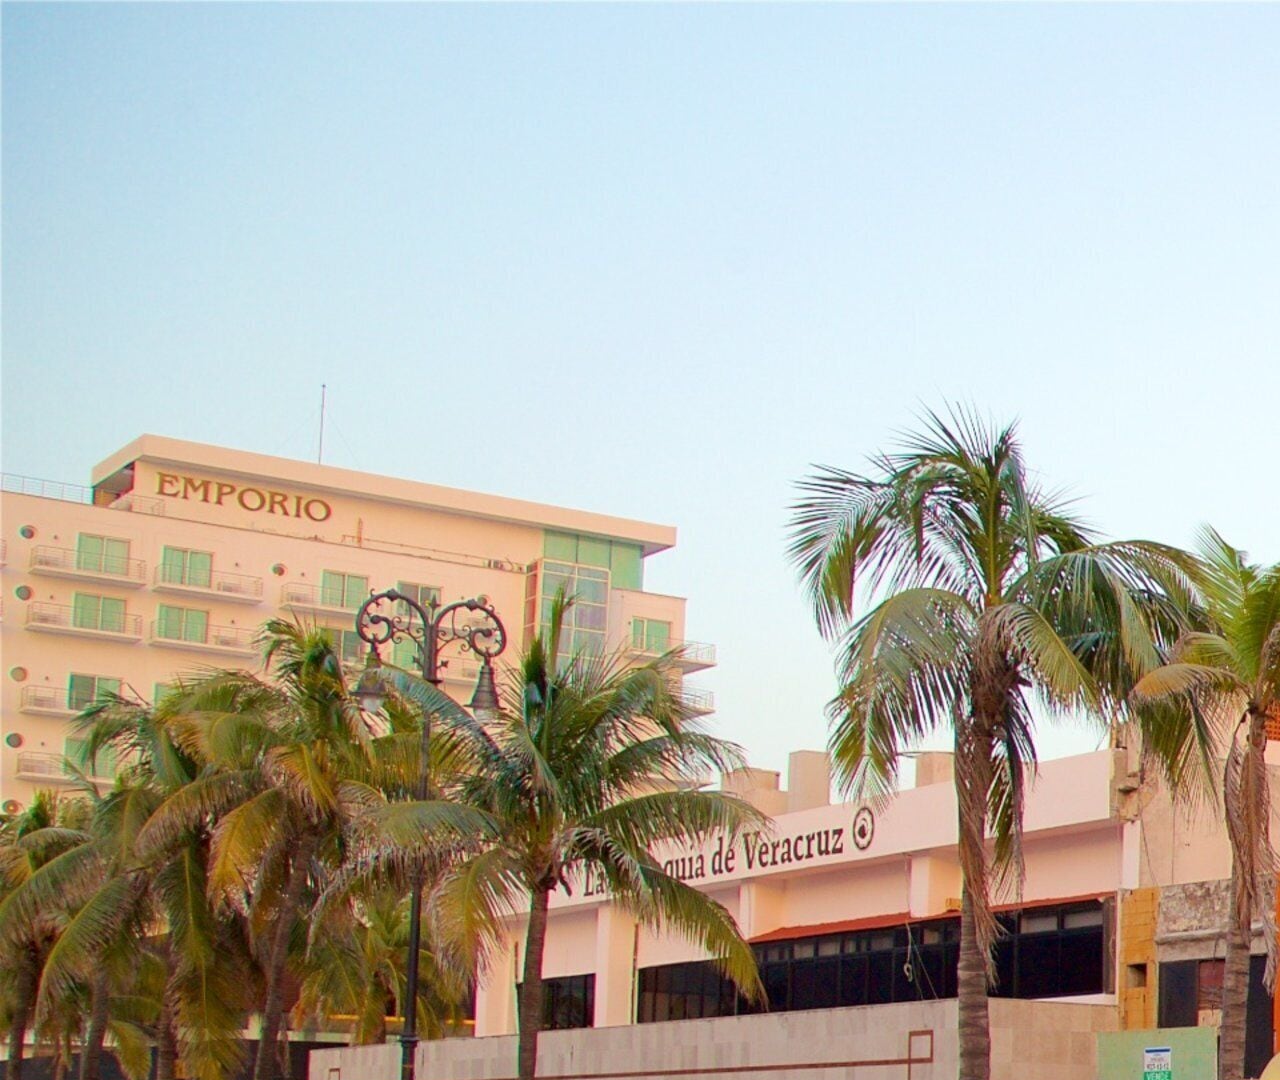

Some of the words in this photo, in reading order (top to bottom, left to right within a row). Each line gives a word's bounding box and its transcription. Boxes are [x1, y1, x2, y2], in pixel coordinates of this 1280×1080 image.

[157, 471, 331, 521] EMPORIO
[712, 837, 735, 876] de
[744, 826, 844, 870] Veracruz
